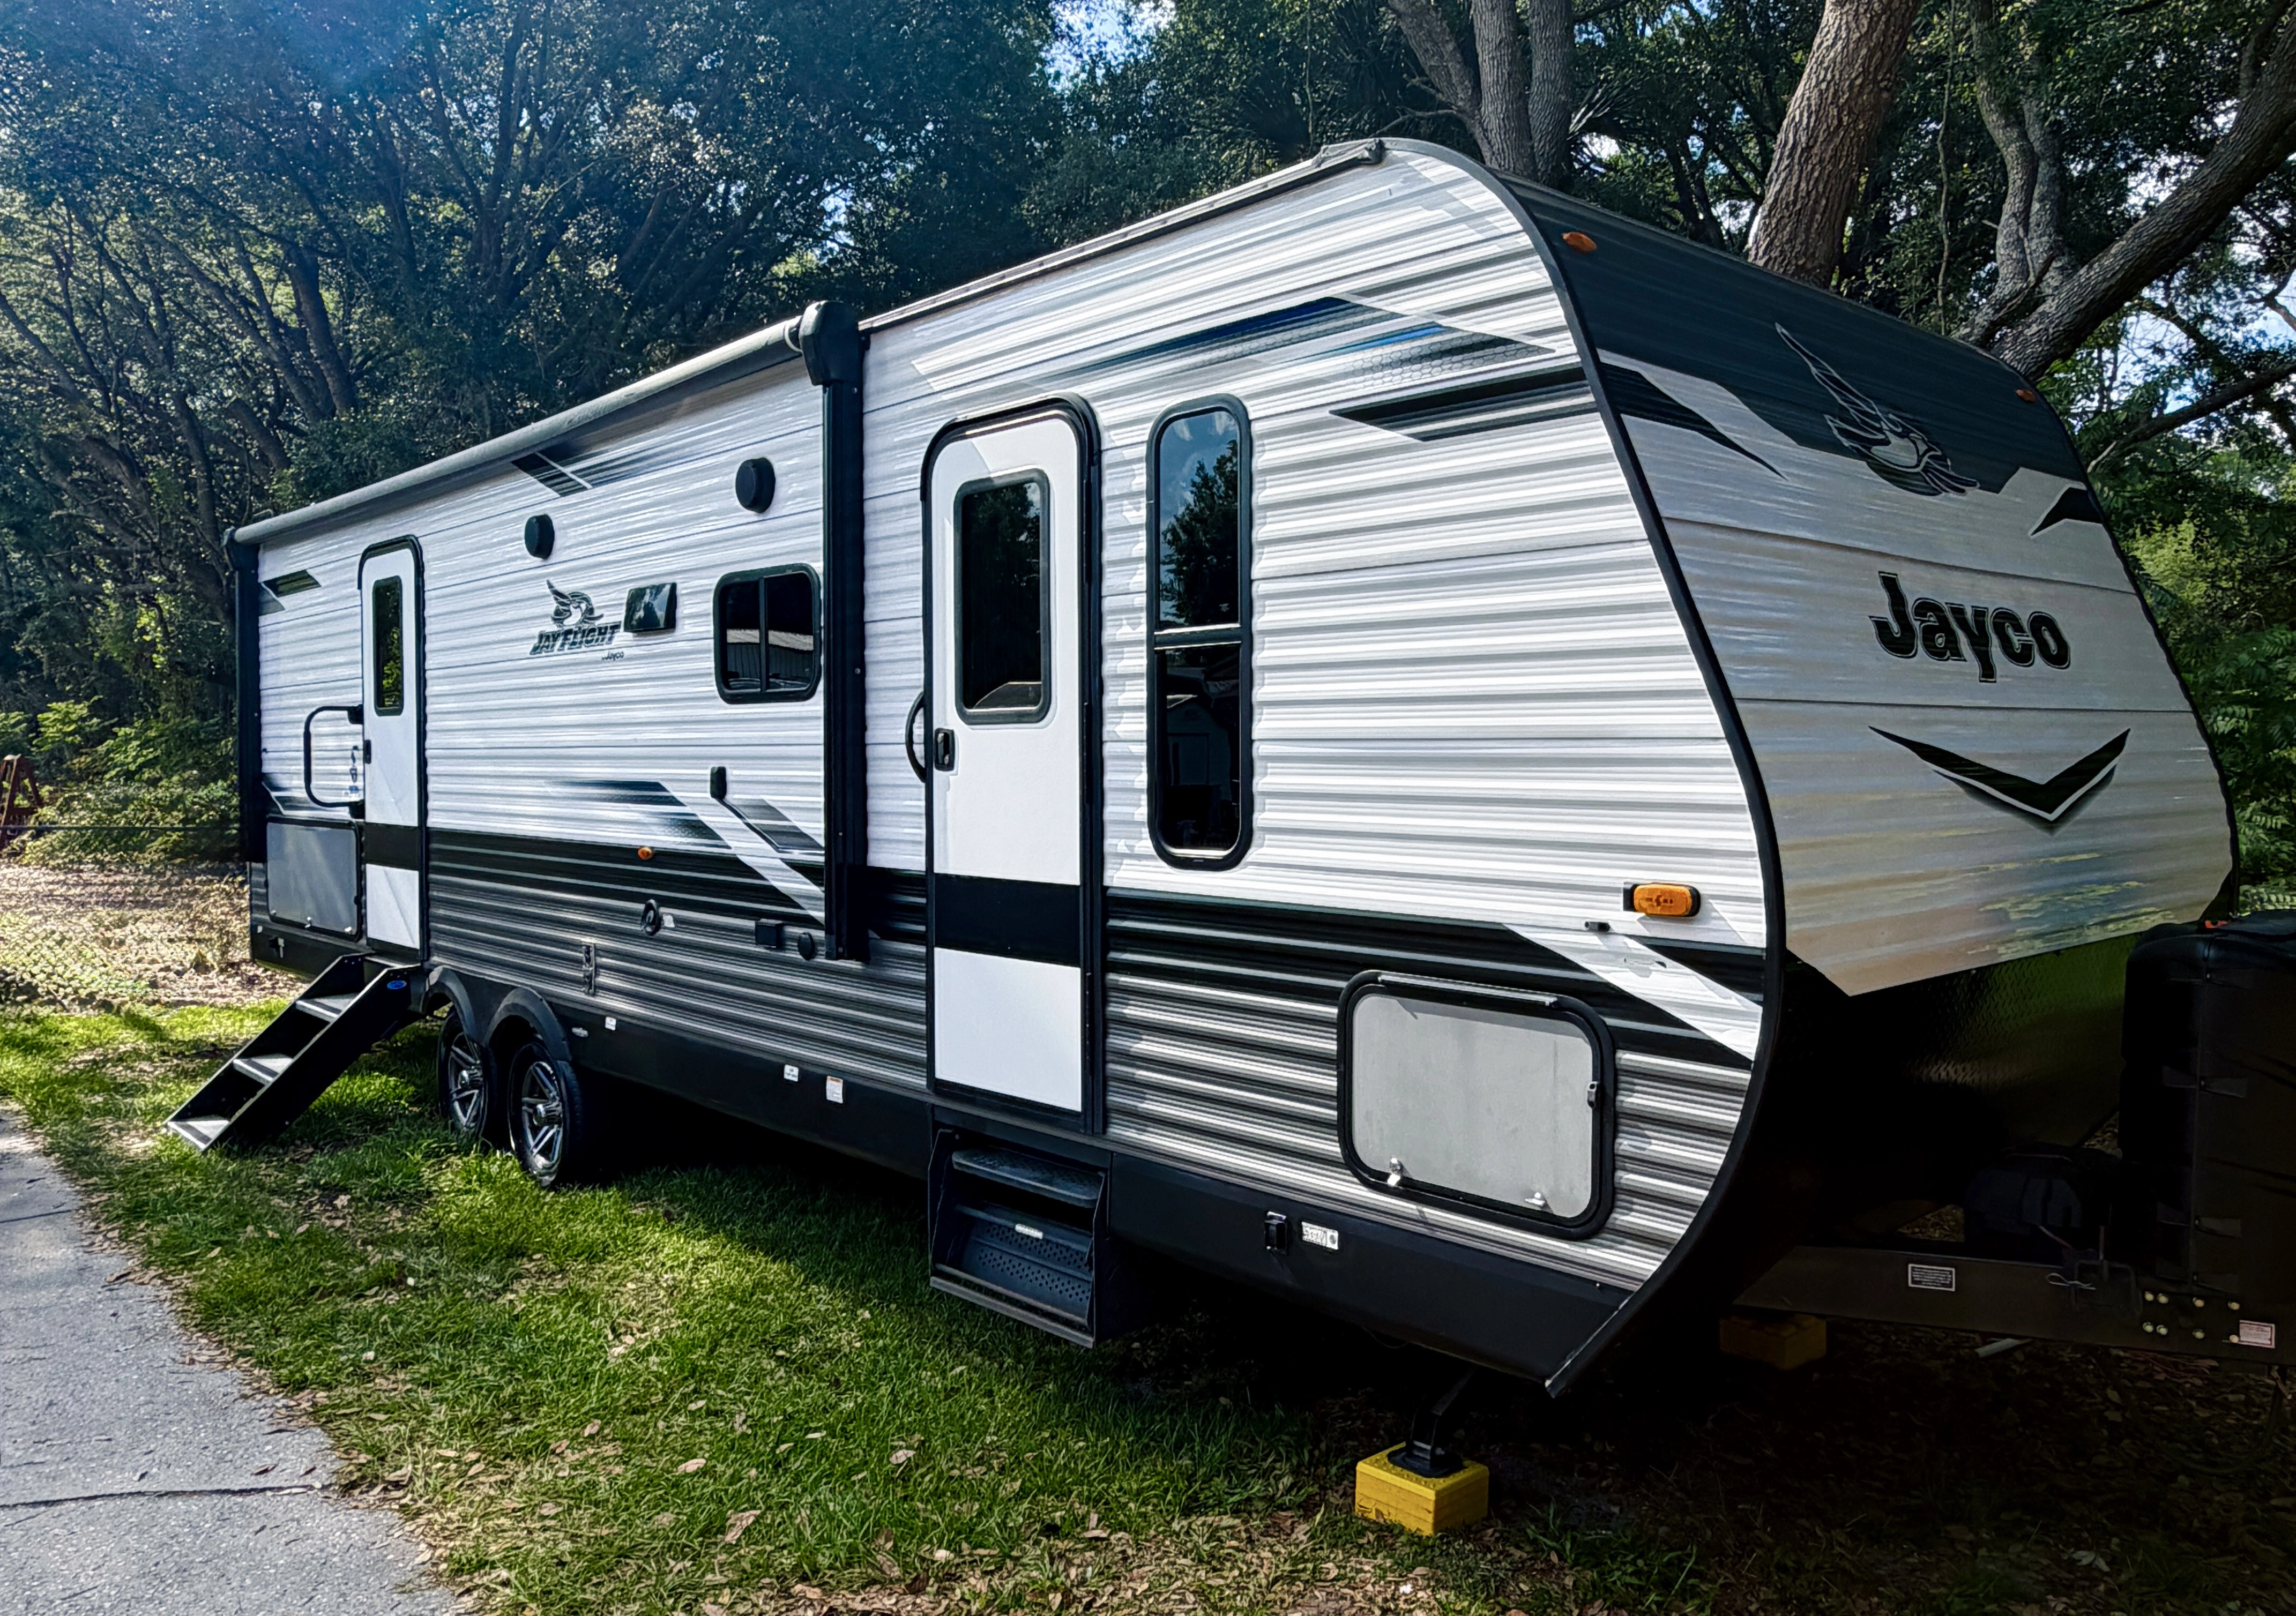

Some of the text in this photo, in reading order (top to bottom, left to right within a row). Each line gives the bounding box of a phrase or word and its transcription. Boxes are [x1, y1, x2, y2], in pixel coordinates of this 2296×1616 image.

[530, 620, 622, 655] JAY FLIGHT
[1868, 571, 2071, 683] Jayco
